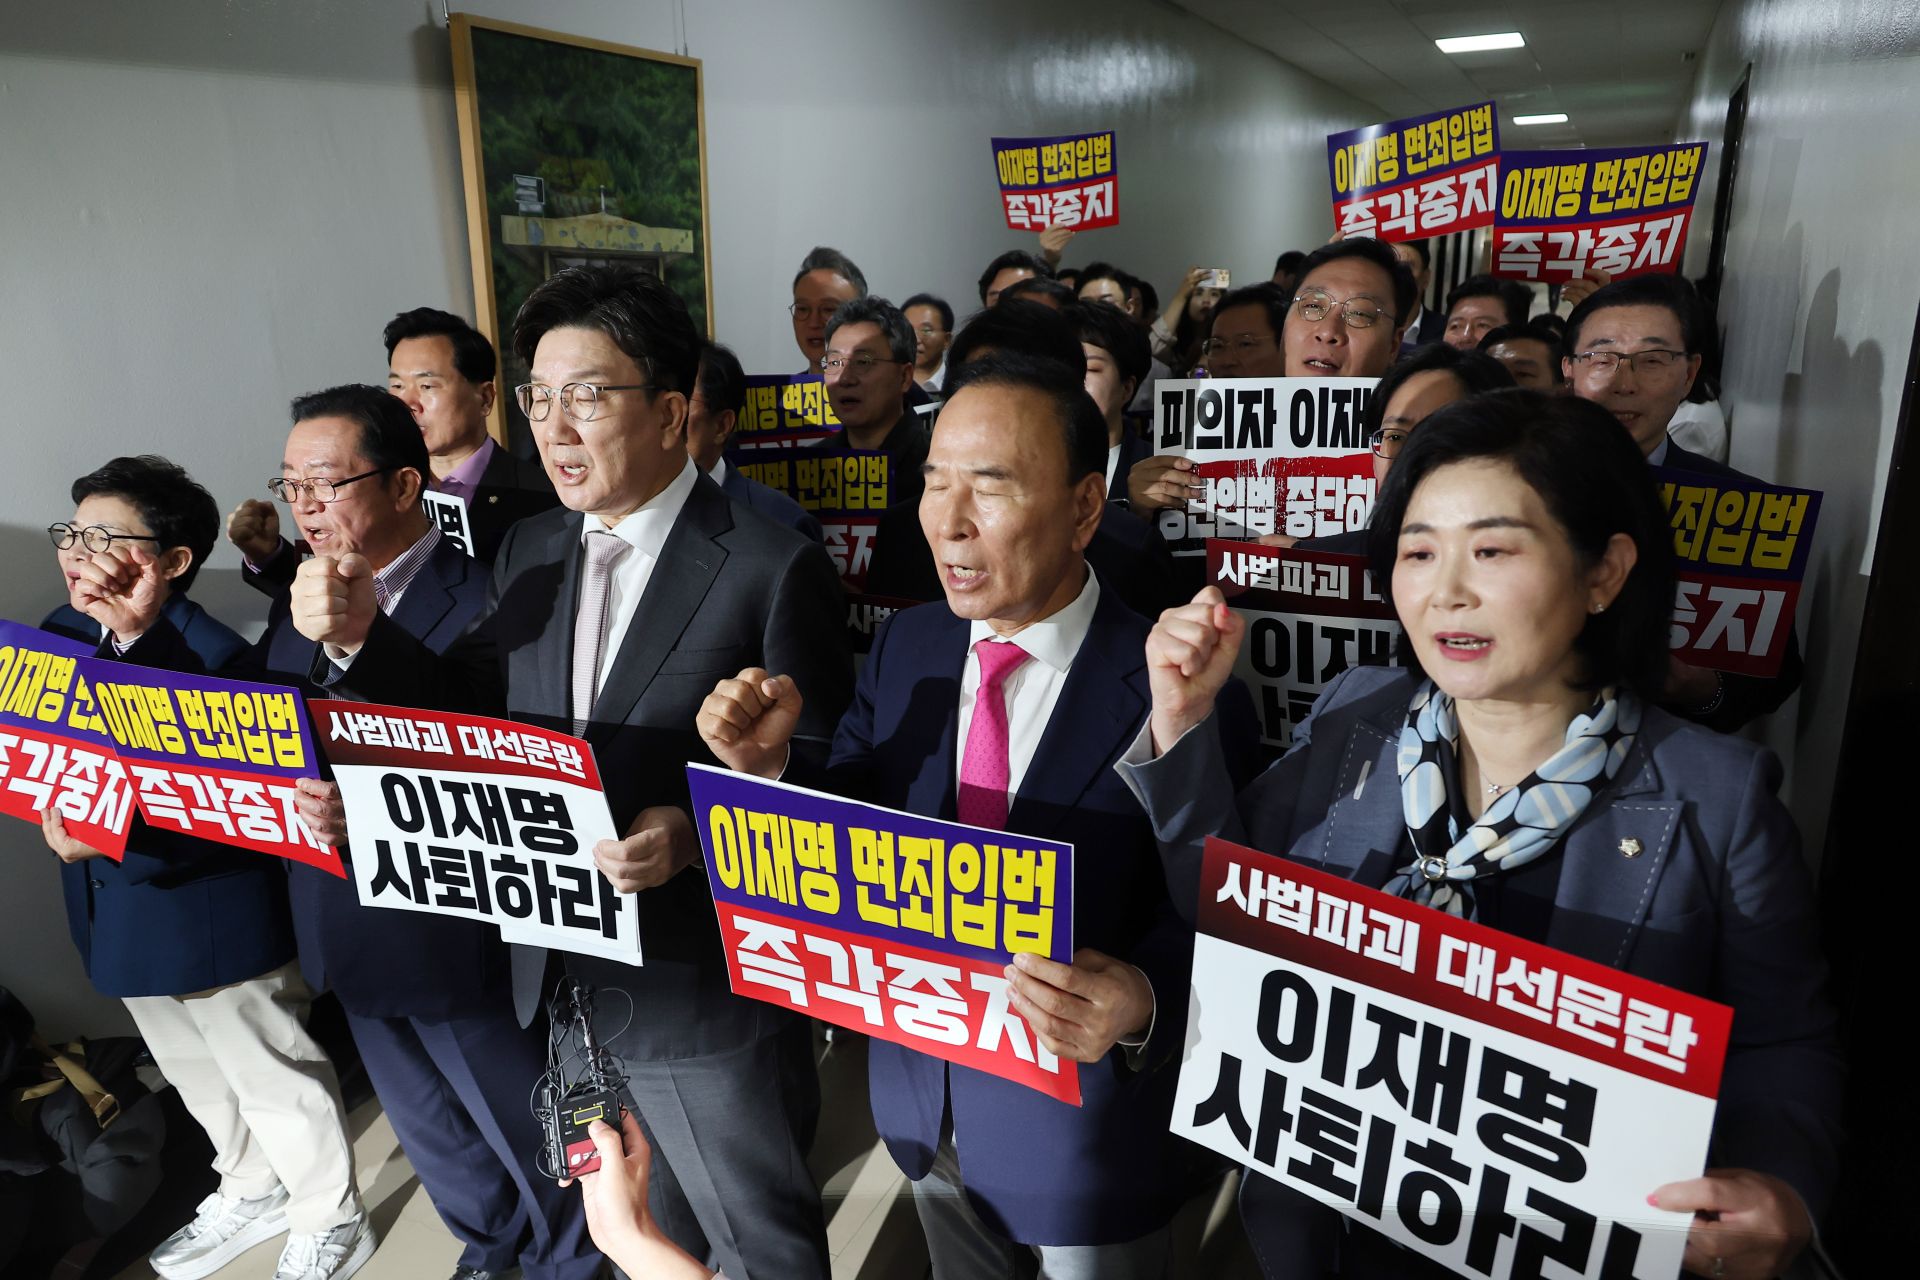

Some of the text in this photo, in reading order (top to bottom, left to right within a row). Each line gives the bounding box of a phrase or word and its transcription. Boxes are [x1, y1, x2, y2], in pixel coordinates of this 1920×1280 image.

[998, 134, 1111, 185] 이재명 면죄입법
[1335, 104, 1493, 193] 이재명 면죄입법
[1501, 146, 1701, 219] 이재명 면죄입법
[1006, 181, 1113, 228] 즉각중지
[1340, 163, 1497, 240] 즉각중지
[1499, 213, 1685, 279] 즉각중지
[1161, 388, 1277, 449] 피의자
[795, 455, 888, 511] 면죄입법
[1657, 483, 1810, 570] 죄입법
[1218, 551, 1350, 600] 사법파괴
[96, 682, 306, 768] 이재명 면죄입법
[330, 711, 586, 780] 사법파괴 대선문란
[380, 773, 580, 857] 이재명
[370, 839, 623, 941] 사퇴하라
[709, 804, 1057, 958] 이재명 면죄입법
[1216, 861, 1698, 1074] 사법파괴 대선문란
[1256, 969, 1598, 1183] 이재명
